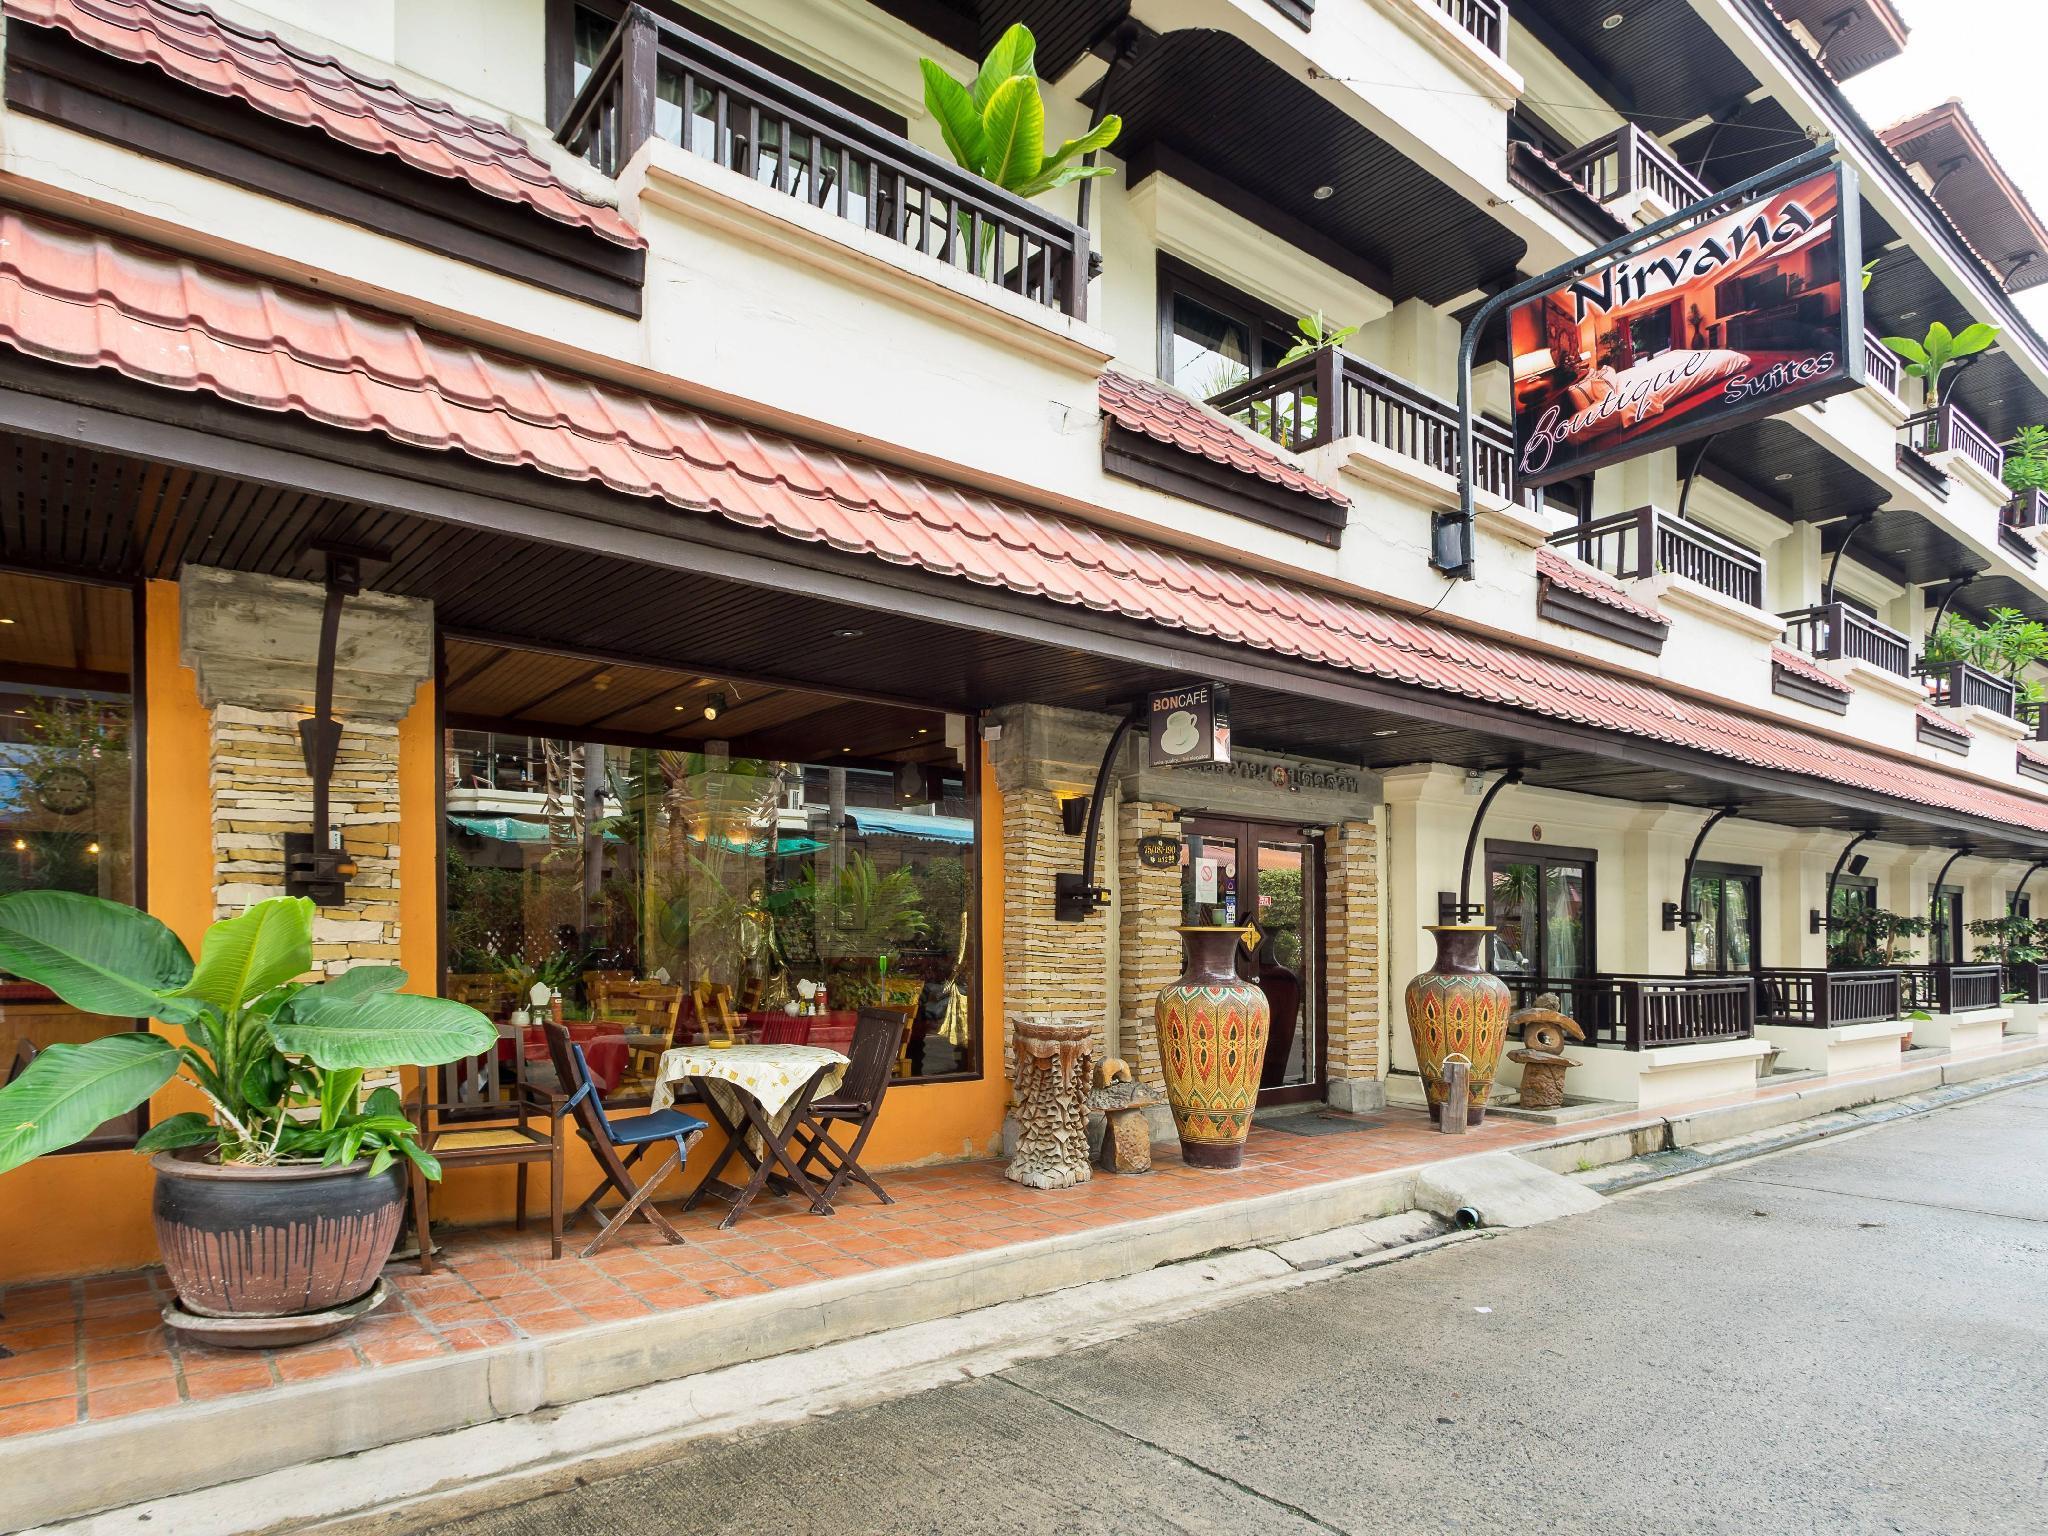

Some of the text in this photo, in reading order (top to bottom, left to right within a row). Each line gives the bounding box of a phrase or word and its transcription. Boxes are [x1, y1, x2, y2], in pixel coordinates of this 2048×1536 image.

[1567, 201, 1816, 325] Nirvana
[1518, 350, 1835, 475] Boutique Suites
[1153, 688, 1208, 712] BONCAFÉ
